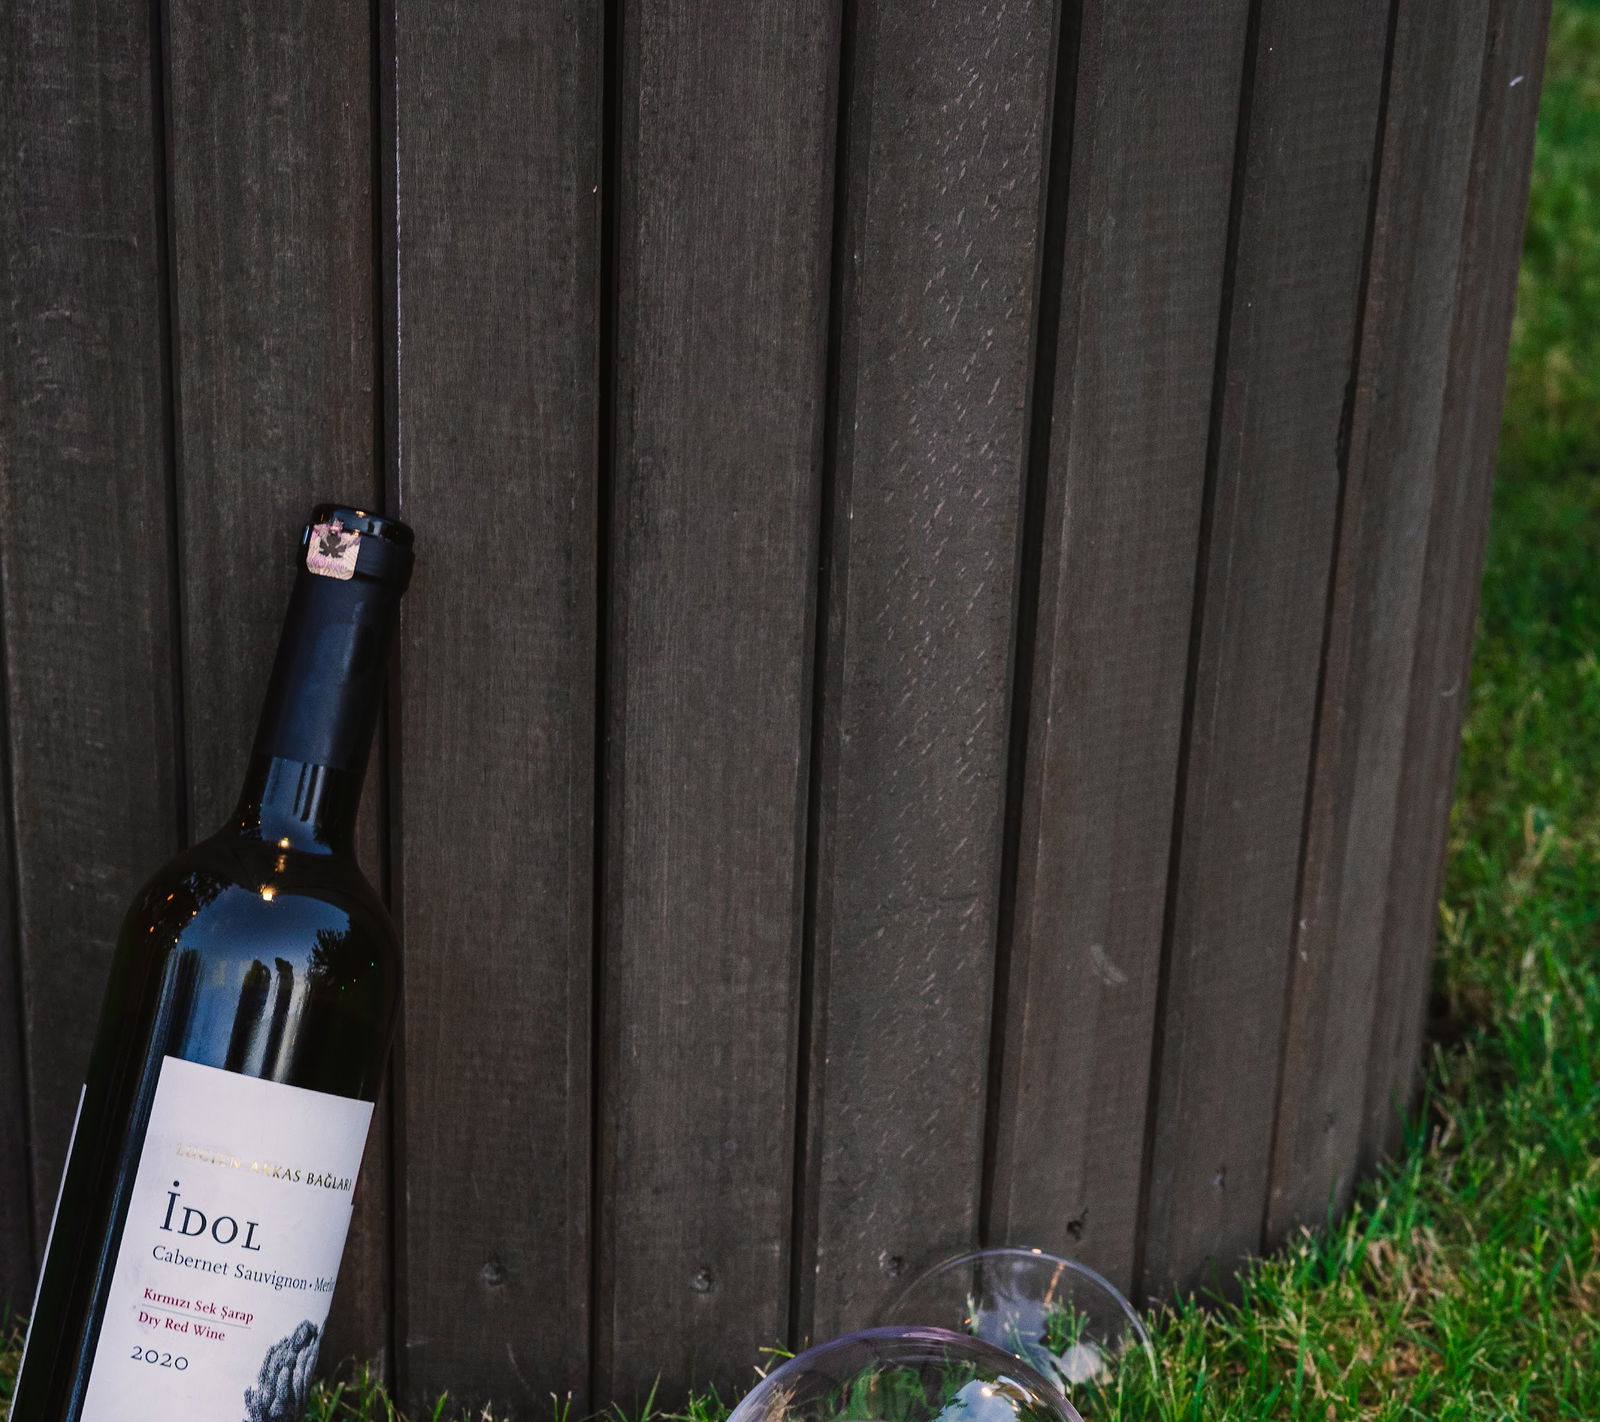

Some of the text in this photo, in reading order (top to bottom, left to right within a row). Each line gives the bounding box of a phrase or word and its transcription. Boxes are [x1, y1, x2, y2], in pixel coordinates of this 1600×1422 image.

[250, 1161, 301, 1182] ARKAS
[306, 1172, 352, 1192] BAĞLARI
[160, 1180, 261, 1251] İDOL
[152, 1245, 229, 1275] Cabernet
[234, 1264, 307, 1291] Sauvignon
[143, 1288, 254, 1325] Kırmızı Sek Şarap
[138, 1311, 225, 1341] Dry Red Wine
[131, 1346, 188, 1371] 2020
